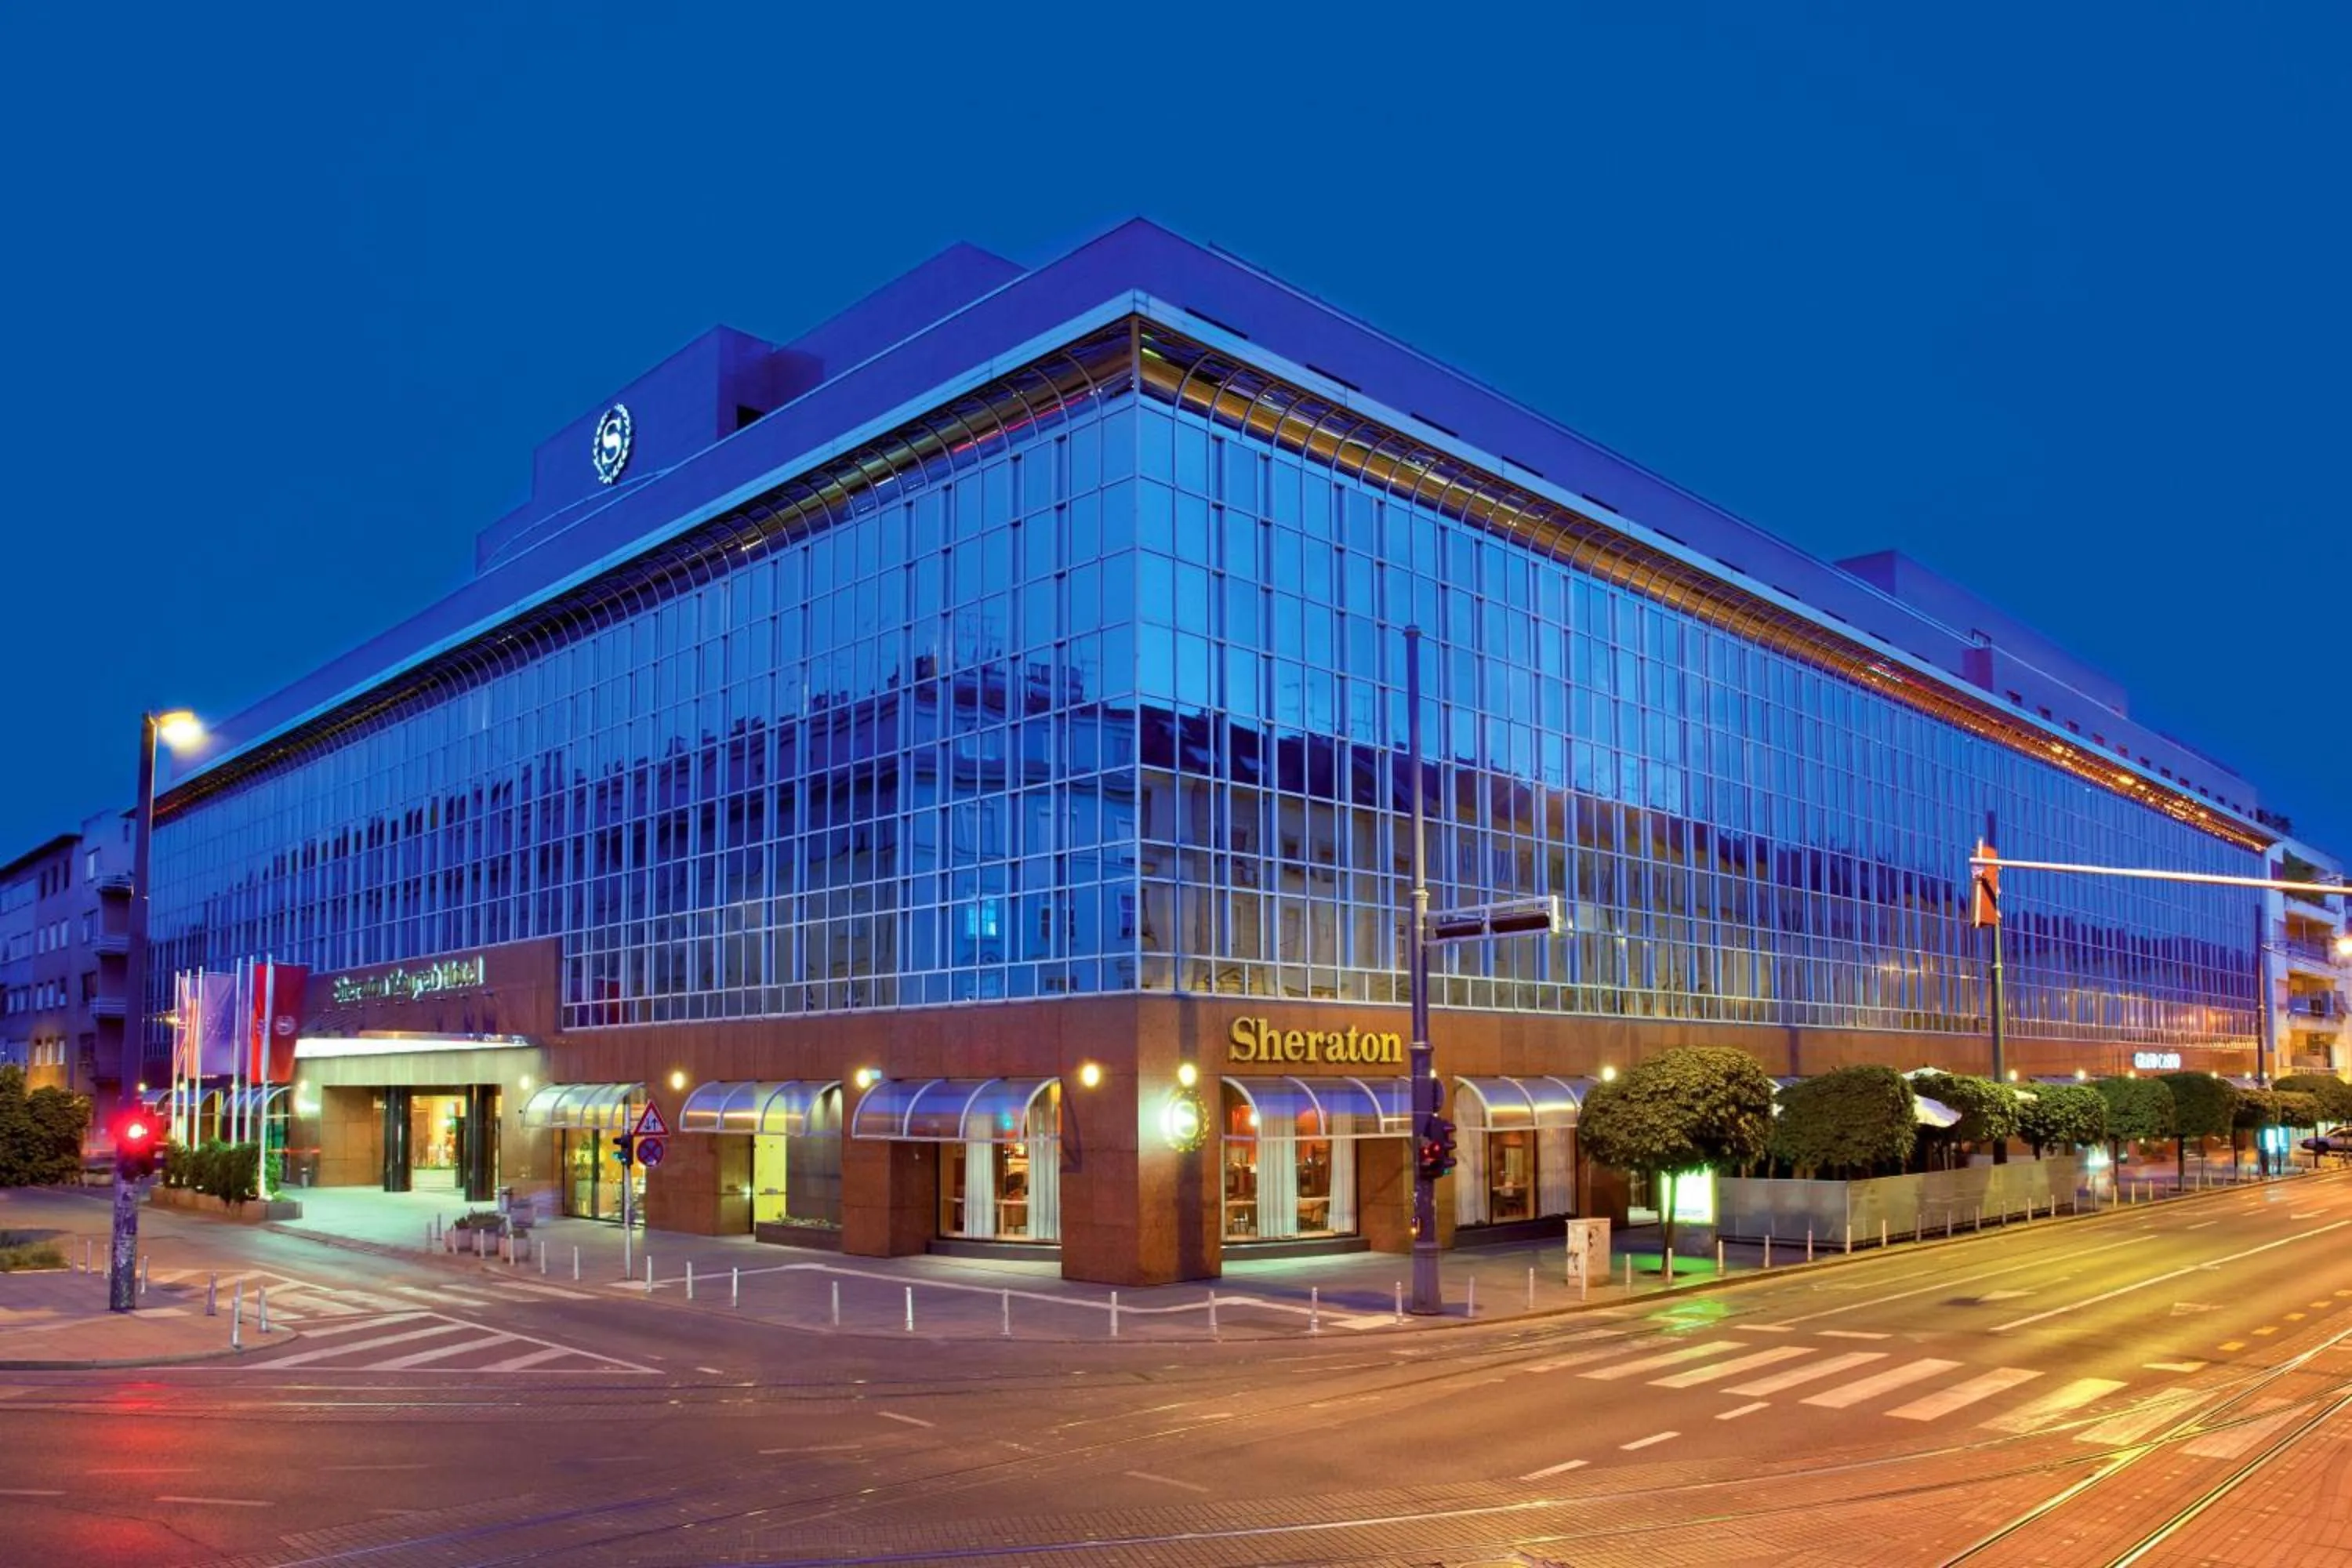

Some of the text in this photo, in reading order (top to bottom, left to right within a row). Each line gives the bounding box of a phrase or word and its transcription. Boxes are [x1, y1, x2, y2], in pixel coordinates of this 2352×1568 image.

[602, 416, 622, 465] S
[443, 956, 485, 989] Hotel
[1229, 1016, 1403, 1063] Sheraton
